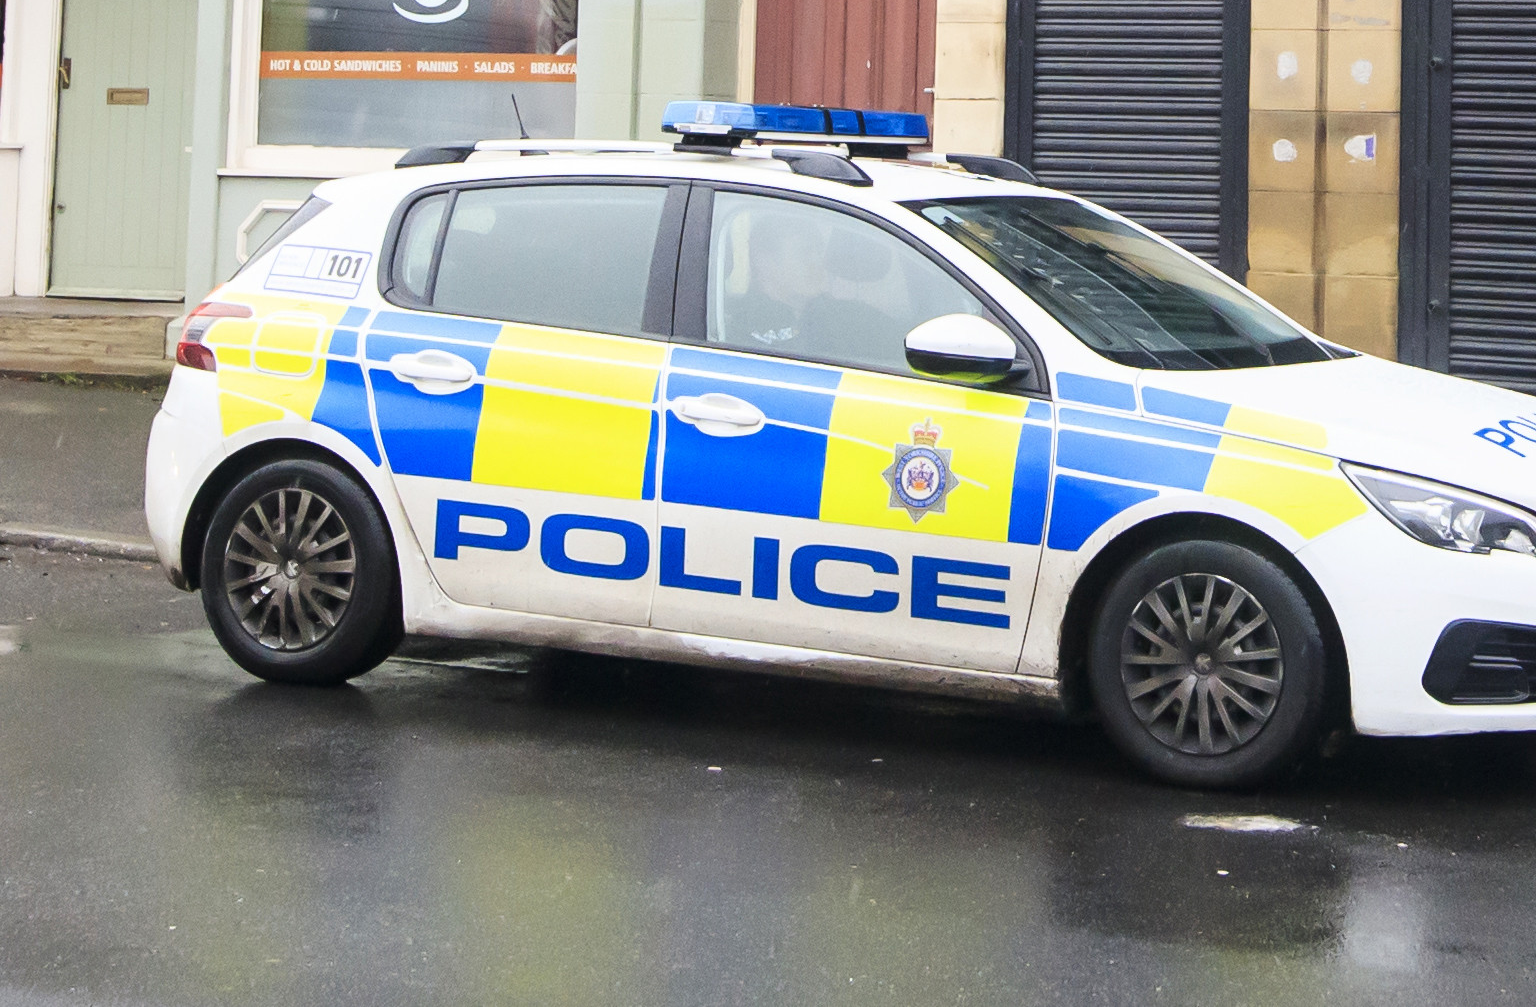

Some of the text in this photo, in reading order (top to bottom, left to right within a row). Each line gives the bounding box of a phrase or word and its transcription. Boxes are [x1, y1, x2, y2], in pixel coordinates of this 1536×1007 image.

[270, 59, 291, 71] HOT
[293, 59, 301, 71] &
[303, 59, 331, 71] COLD
[333, 59, 401, 72] SANDWICHES
[416, 60, 459, 73] PANINIS
[474, 61, 515, 73] SALADS
[328, 254, 363, 279] 101
[434, 498, 1011, 630] POLICE
